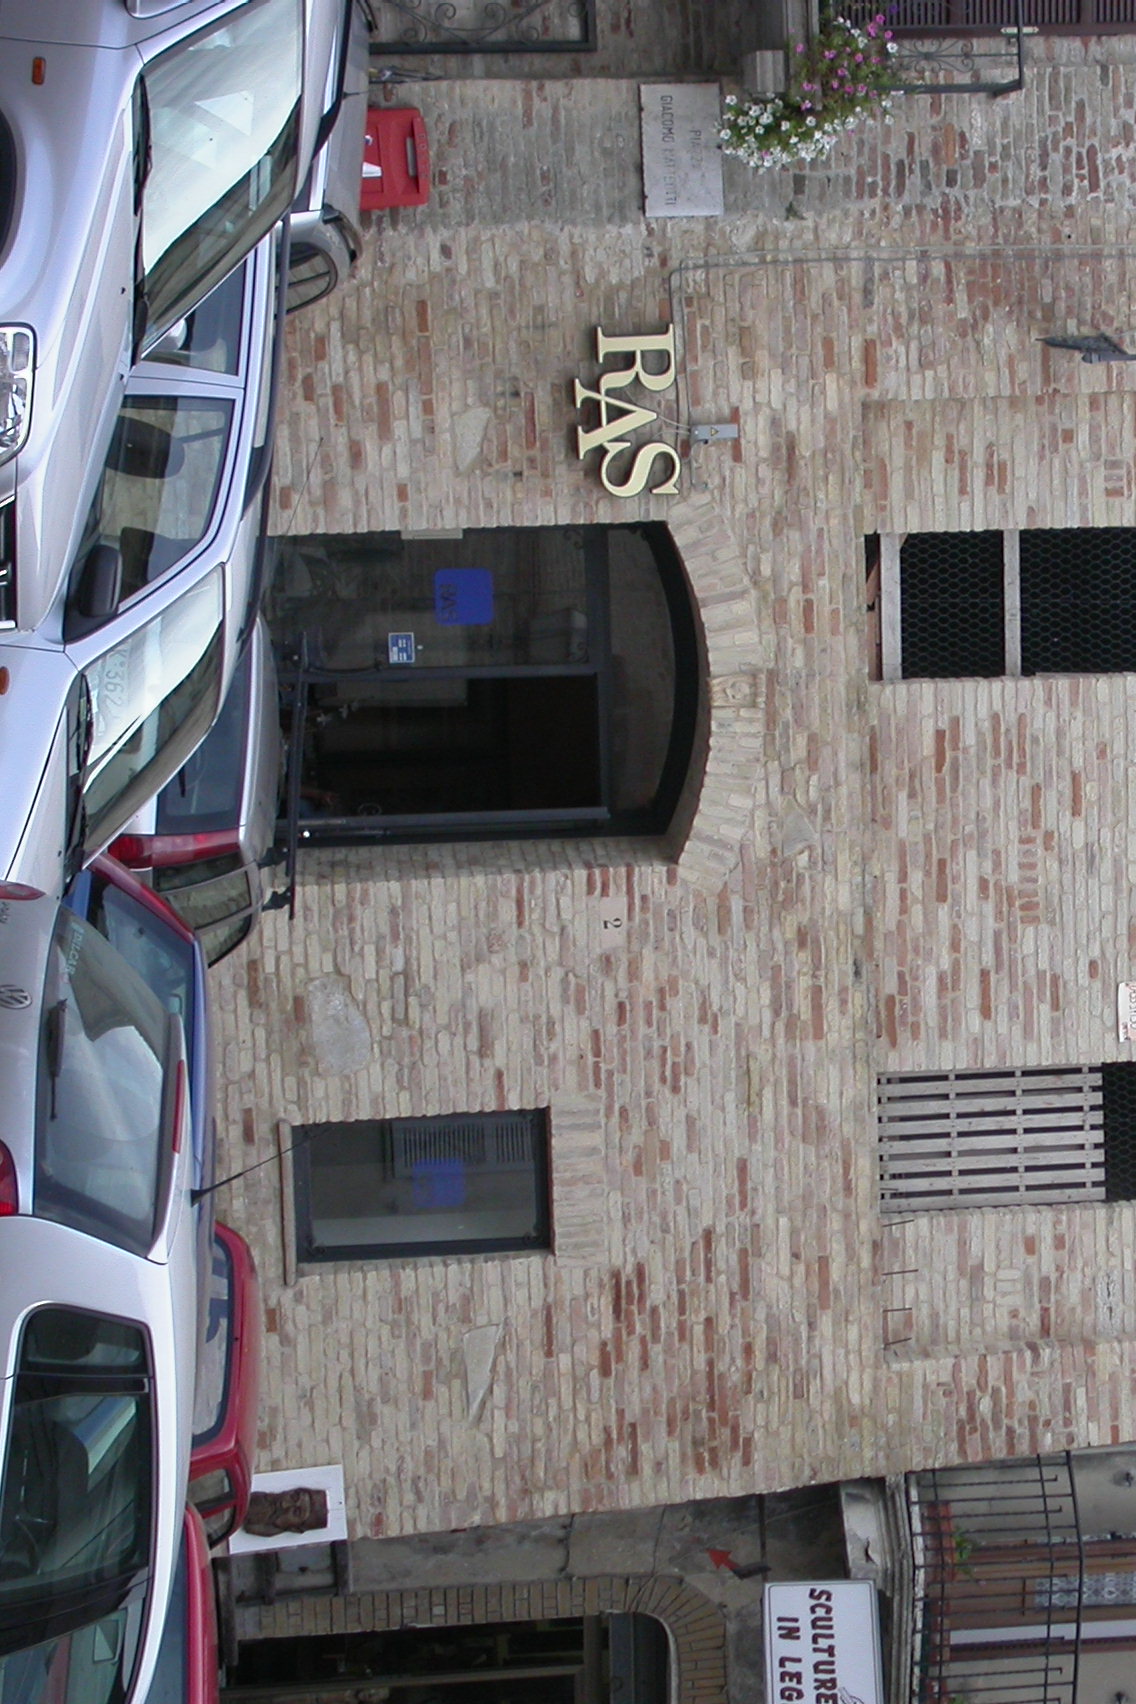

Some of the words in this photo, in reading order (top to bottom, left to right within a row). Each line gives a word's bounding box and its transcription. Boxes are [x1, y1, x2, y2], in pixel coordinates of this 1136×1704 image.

[660, 95, 675, 143] GIACOMO
[573, 322, 681, 498] RAS
[603, 917, 623, 930] 2
[776, 1616, 801, 1641] IN
[808, 1587, 839, 1704] SCULTURE
